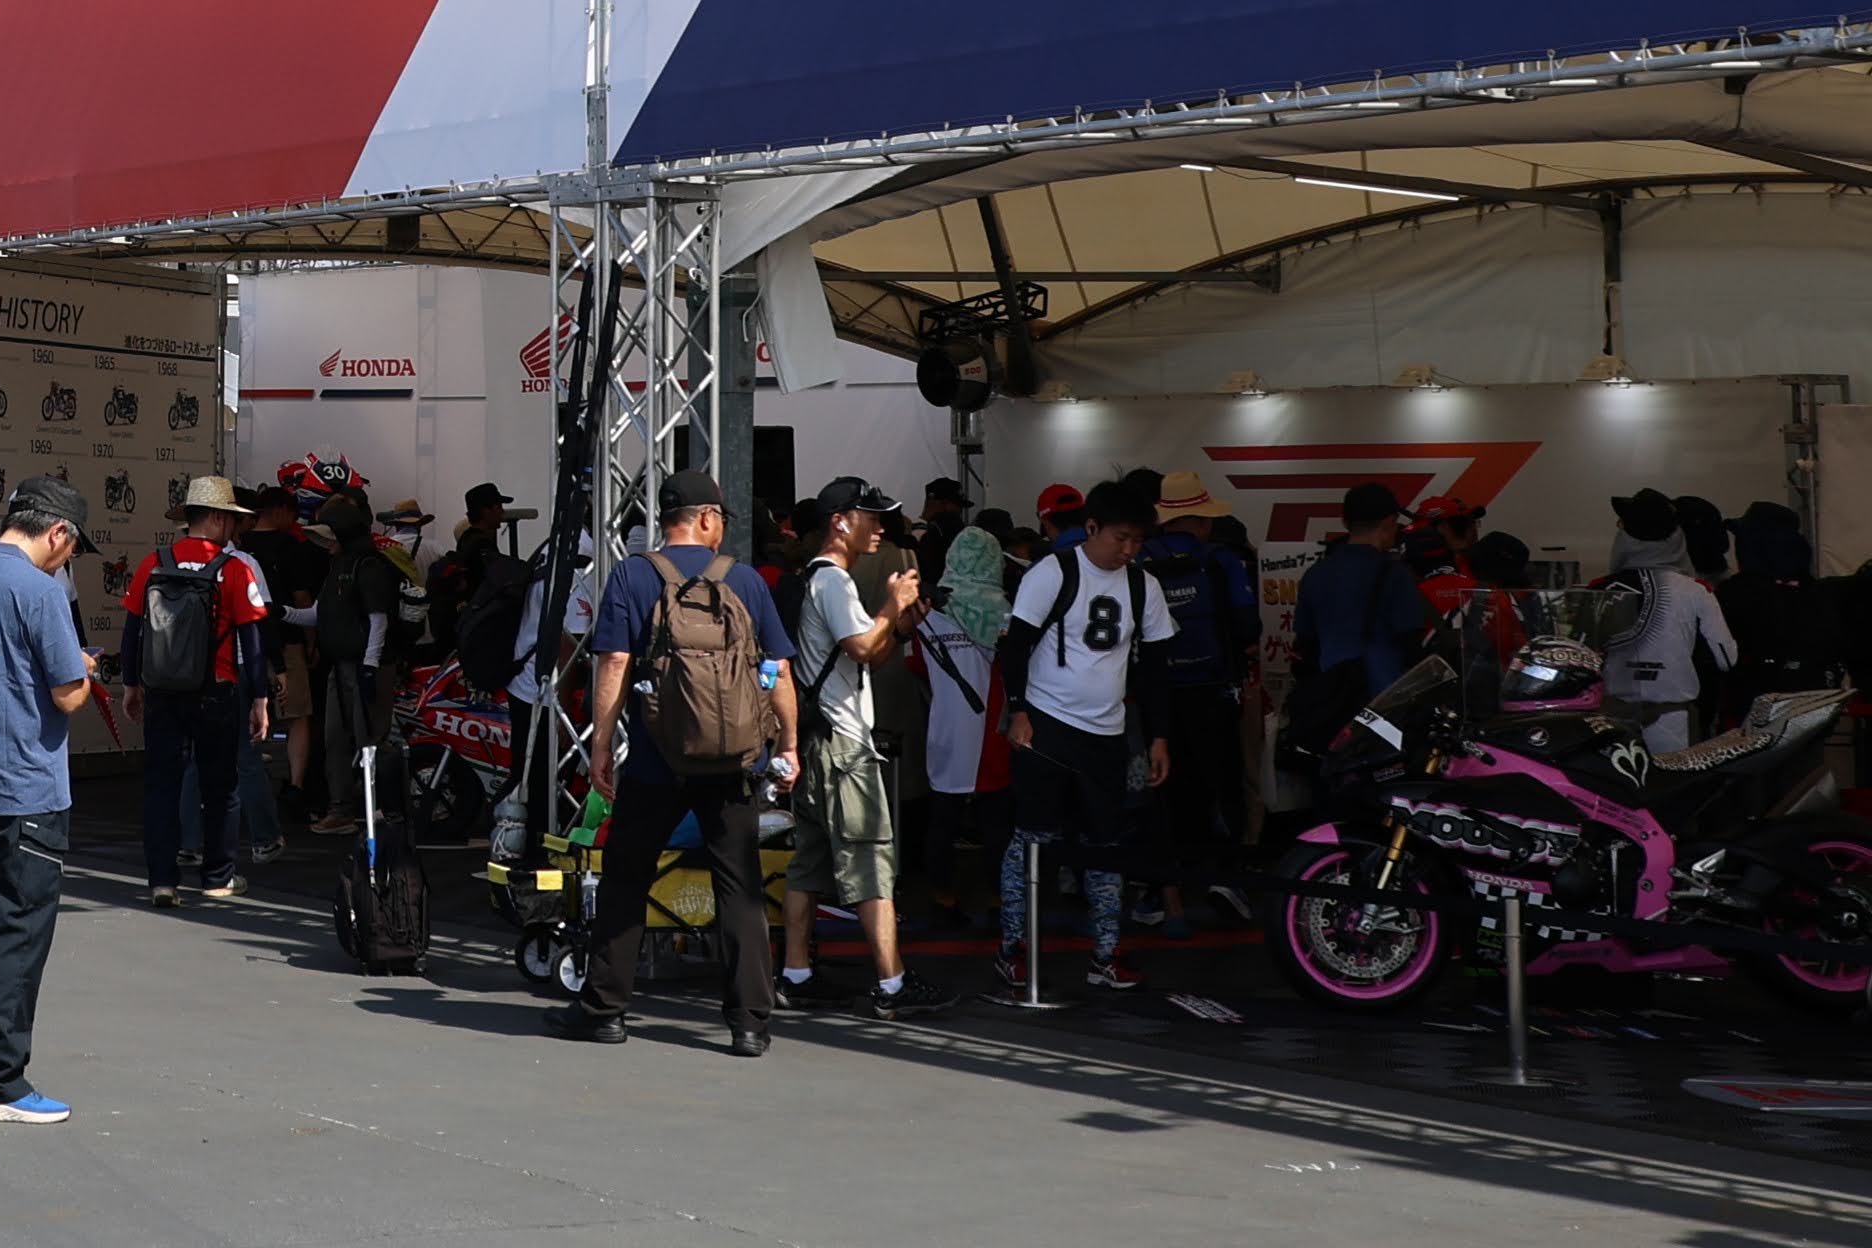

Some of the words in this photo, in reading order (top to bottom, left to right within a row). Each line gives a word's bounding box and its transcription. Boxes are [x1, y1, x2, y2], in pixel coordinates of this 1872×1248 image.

[32, 348, 54, 364] 1960
[94, 355, 115, 370] 1965
[157, 361, 178, 376] 1968
[341, 359, 416, 377] HONDA
[30, 439, 52, 454] 1969
[92, 444, 114, 458] 1970
[155, 448, 175, 461] 1971
[323, 466, 345, 480] 30
[91, 530, 112, 544] 1974
[89, 617, 111, 631] 1980
[1083, 595, 1122, 651] 8
[433, 710, 513, 749] HON
[1468, 868, 1537, 891] HONDA
